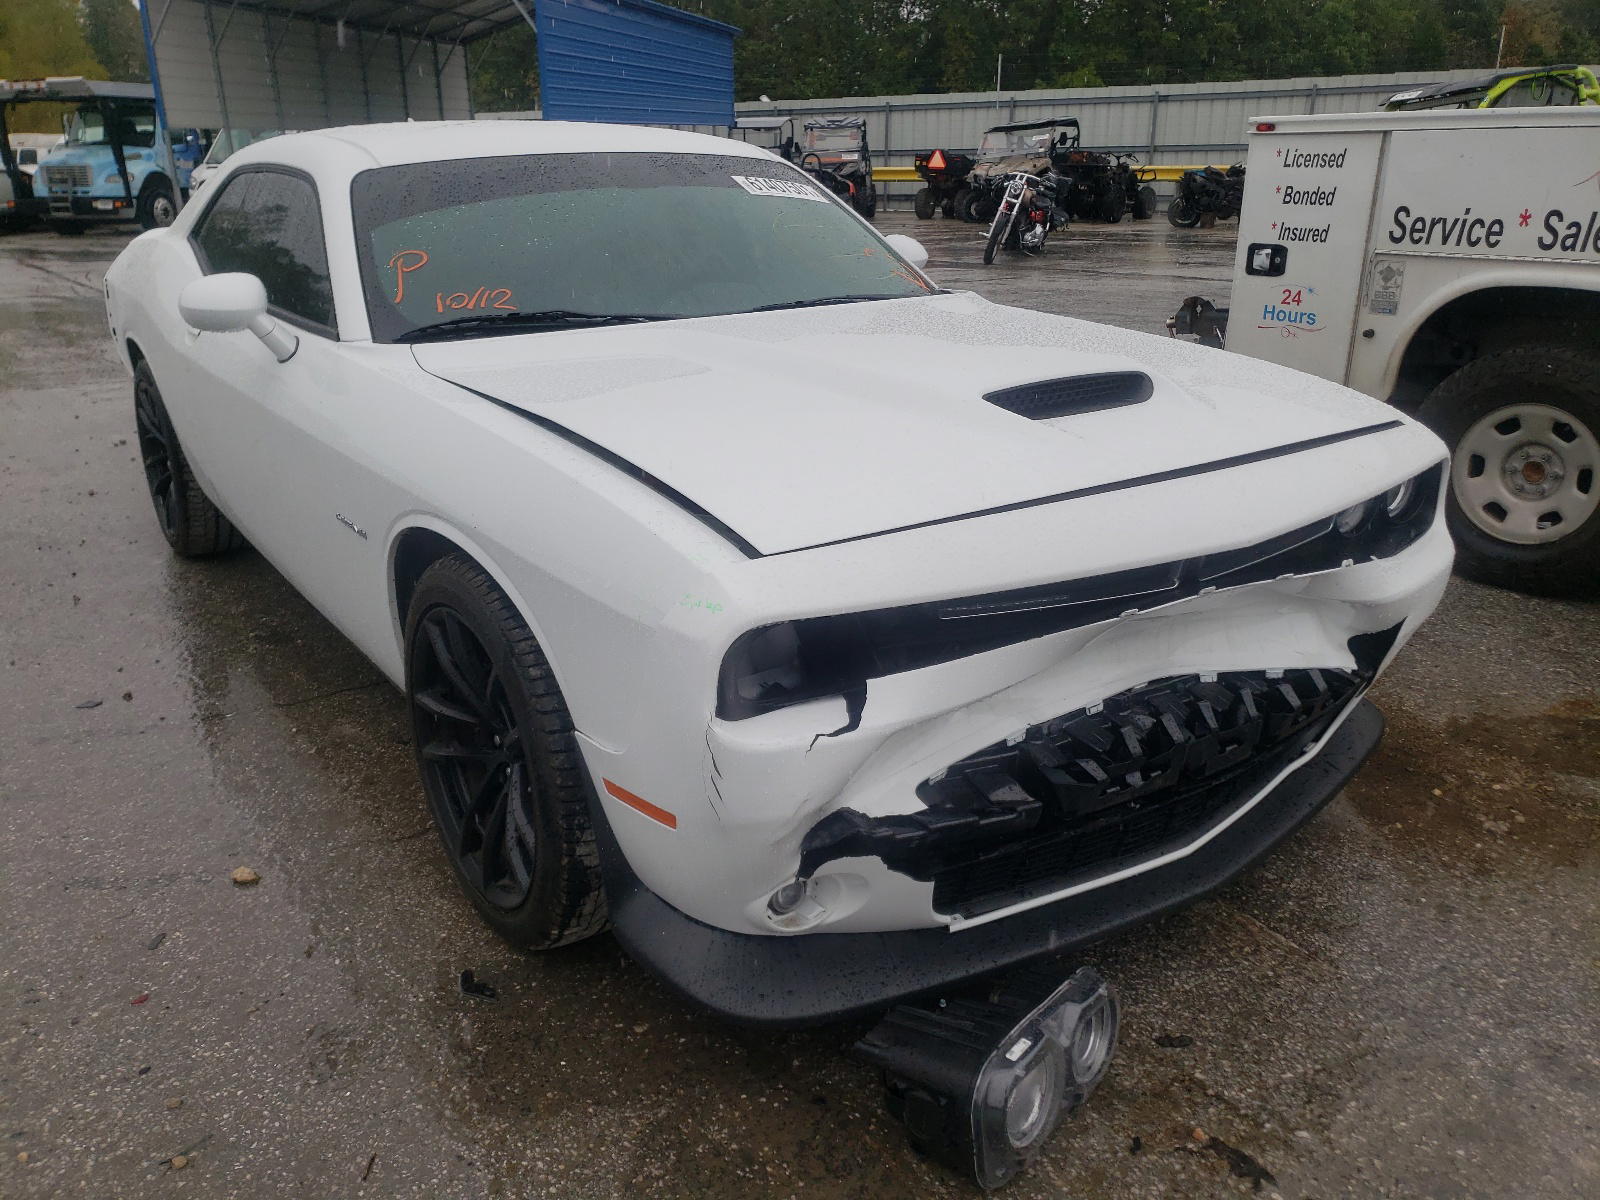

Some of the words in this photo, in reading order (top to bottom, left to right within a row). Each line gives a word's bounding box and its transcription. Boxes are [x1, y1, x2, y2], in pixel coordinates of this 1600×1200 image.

[1283, 148, 1347, 168] Licensed
[1282, 186, 1337, 206] Bonded
[1278, 222, 1331, 243] Insured
[1389, 206, 1504, 249] Service
[436, 286, 518, 313] 10/12
[1281, 289, 1303, 306] 24
[1263, 304, 1316, 326] Hours
